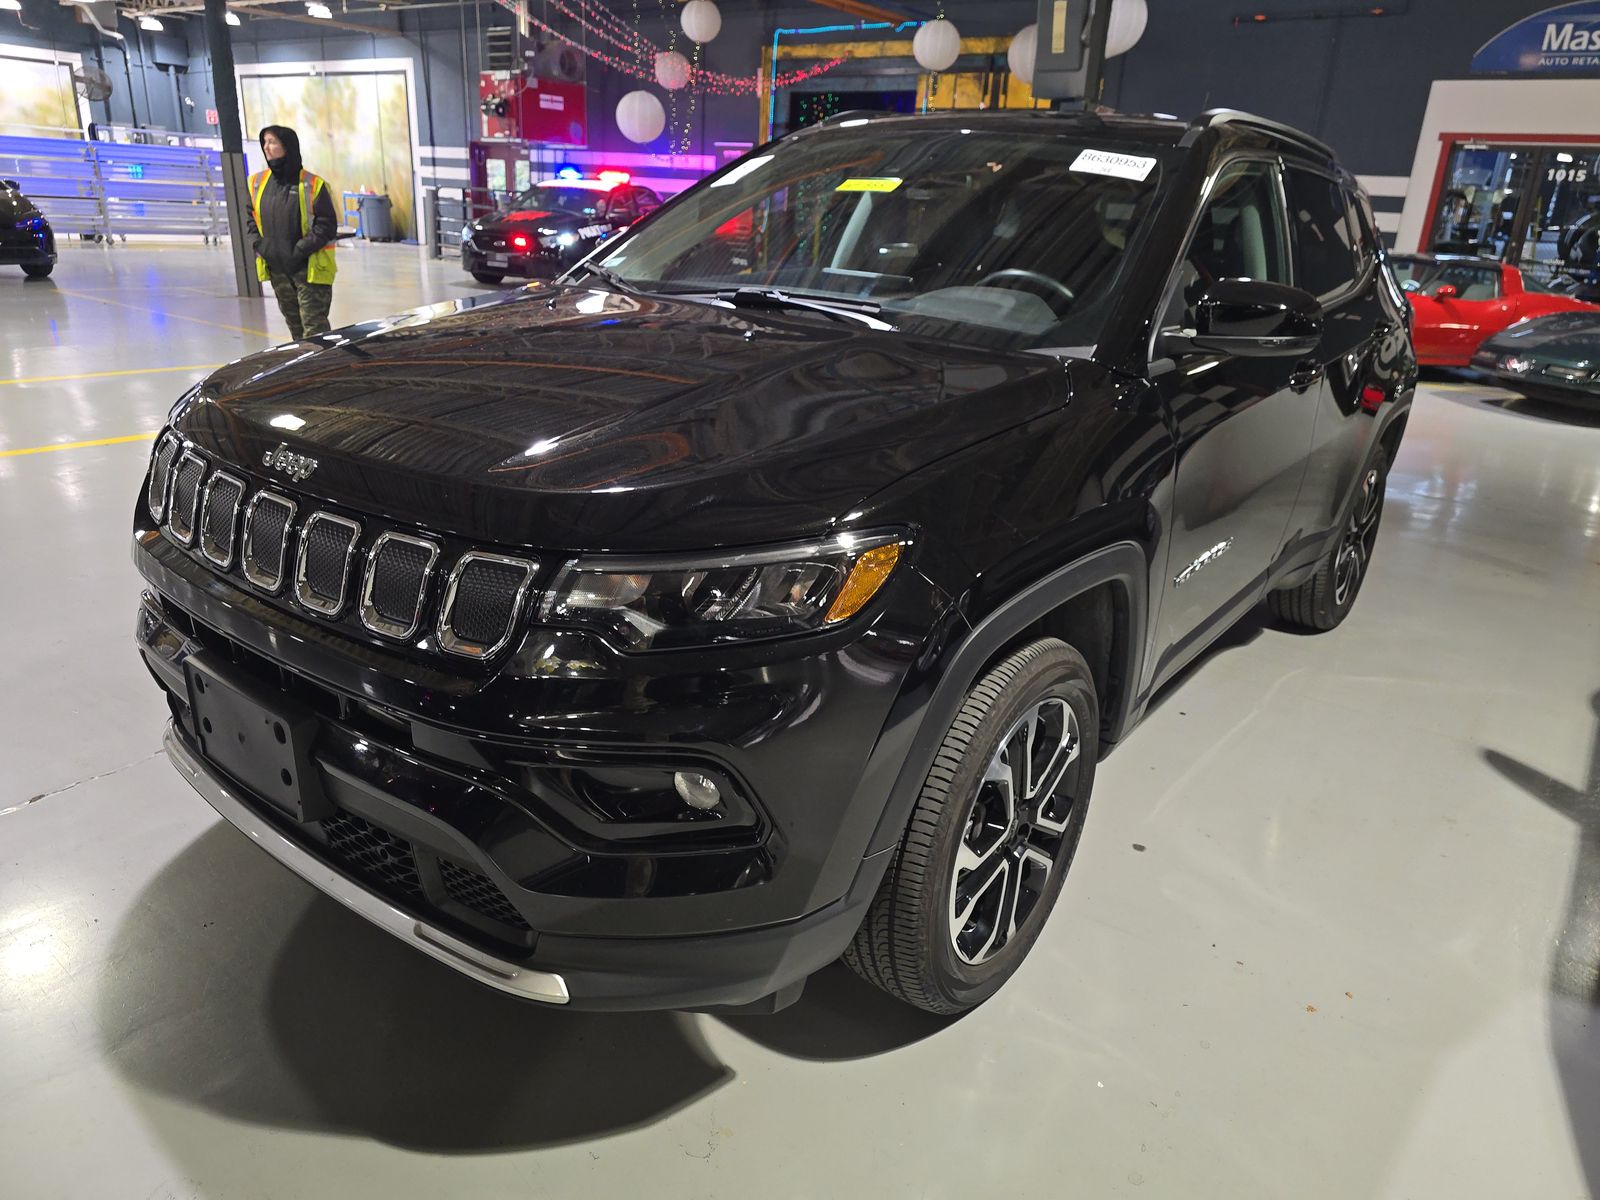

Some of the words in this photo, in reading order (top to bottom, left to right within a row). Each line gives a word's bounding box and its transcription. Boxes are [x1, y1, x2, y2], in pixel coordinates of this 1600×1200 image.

[1538, 56, 1569, 66] AUTO
[1081, 151, 1148, 169] 8630953
[1547, 168, 1587, 183] 1015
[262, 441, 318, 483] Jeep
